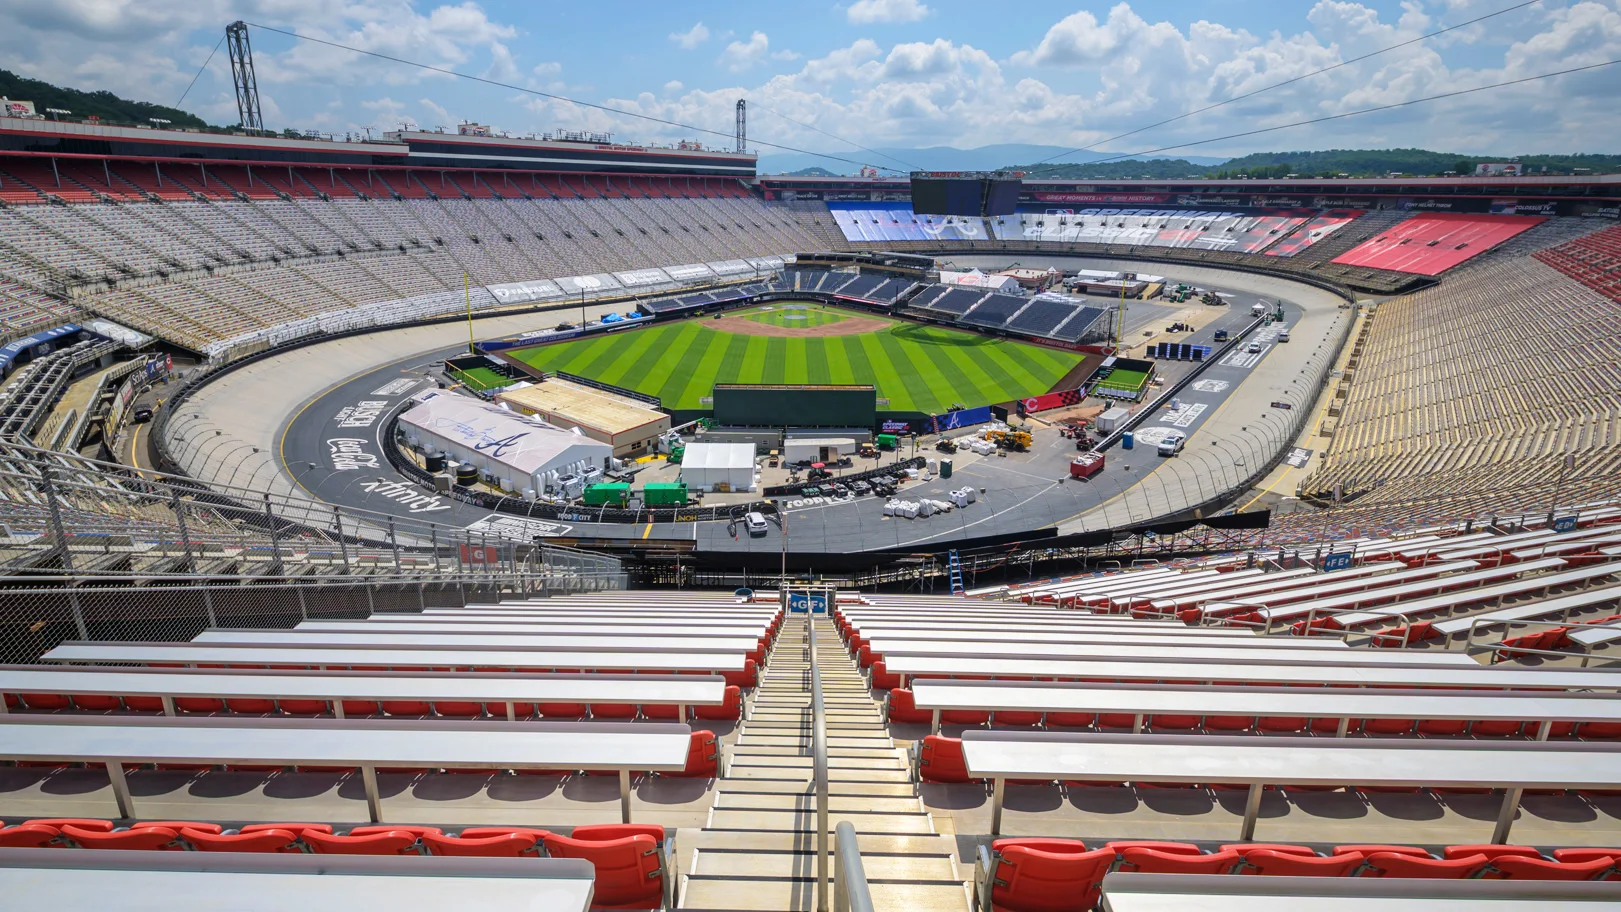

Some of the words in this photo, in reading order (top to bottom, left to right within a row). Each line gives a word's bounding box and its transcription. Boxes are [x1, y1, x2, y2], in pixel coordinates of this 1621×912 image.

[1078, 208, 1245, 221] SPEEDWAY
[1022, 227, 1158, 238] CLASSIC
[340, 401, 388, 427] BUSCH
[401, 468, 420, 485] BRISTOL
[360, 481, 451, 512] xfinity
[1558, 521, 1570, 529] ED
[474, 550, 484, 559] G
[1331, 558, 1345, 567] FE
